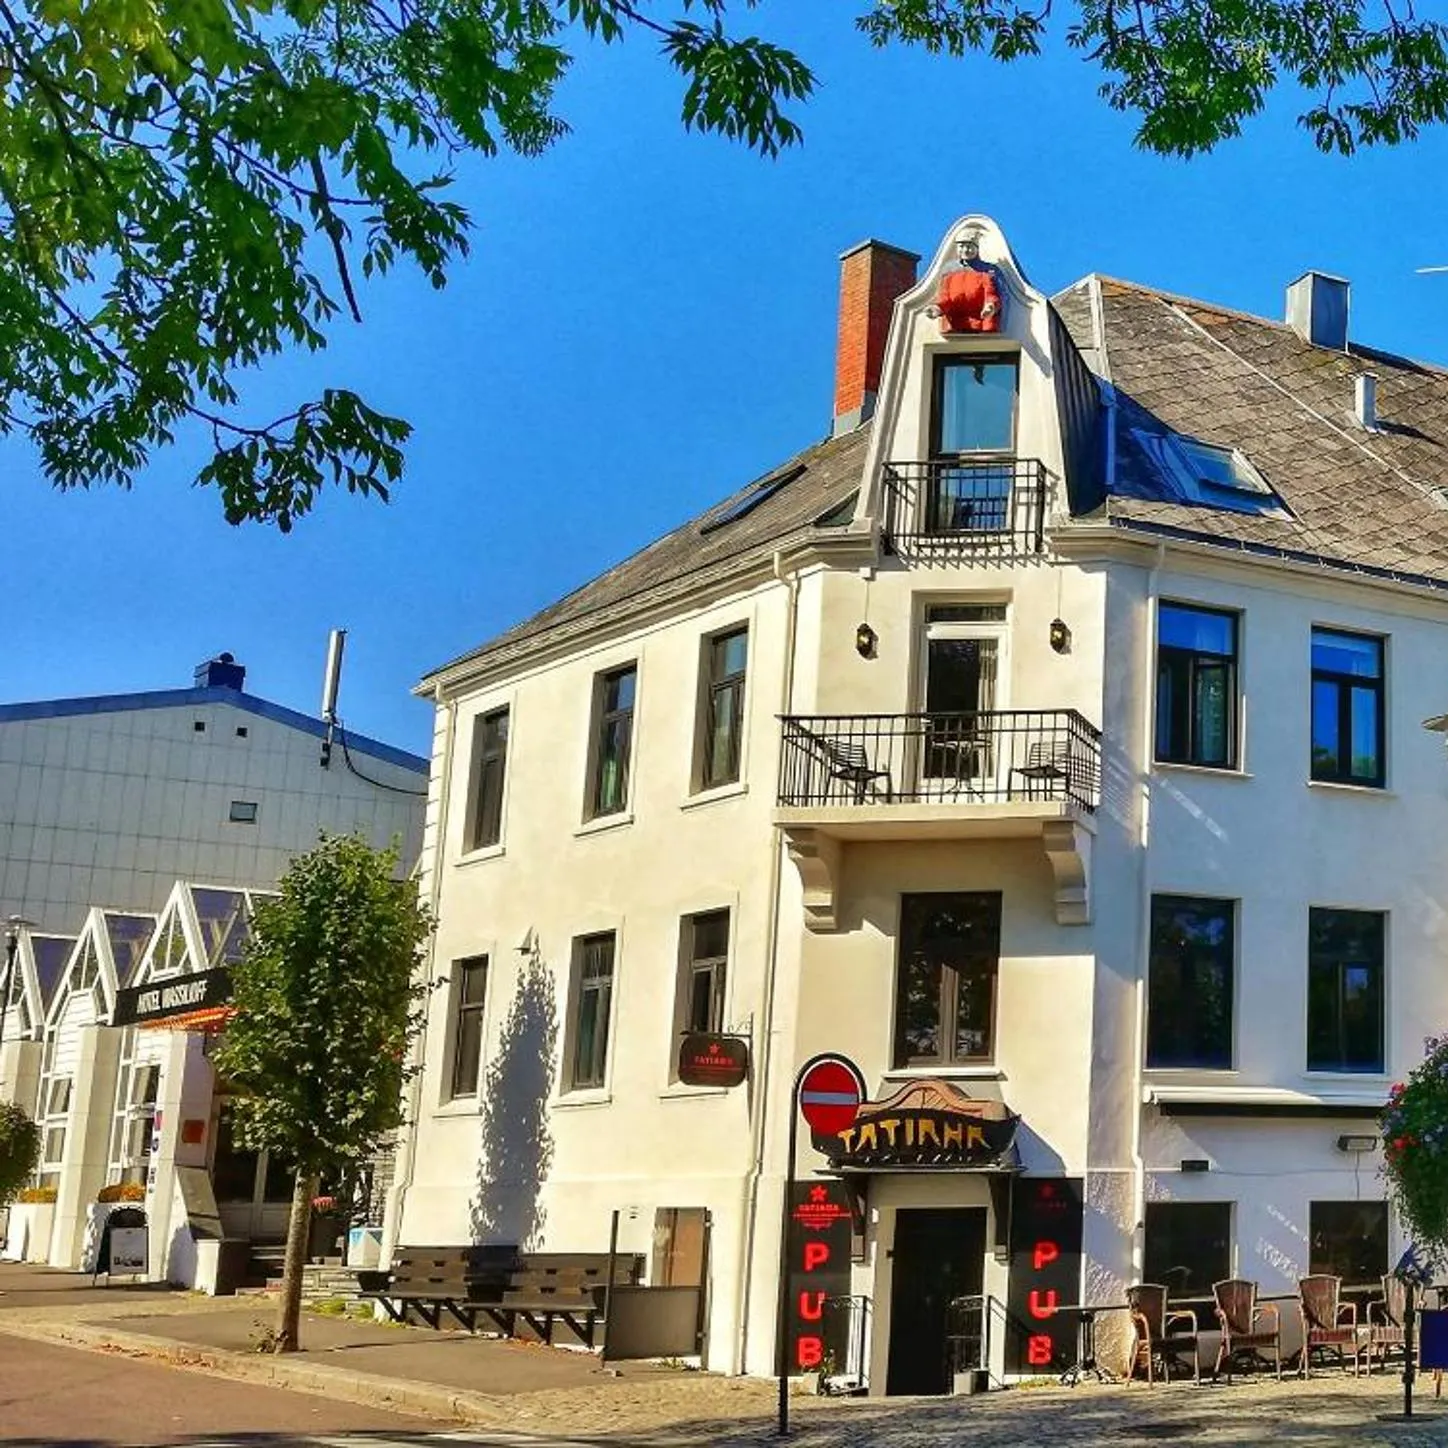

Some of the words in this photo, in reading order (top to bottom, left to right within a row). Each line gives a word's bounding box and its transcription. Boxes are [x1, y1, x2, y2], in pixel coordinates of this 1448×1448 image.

[137, 988, 160, 1014] HOTEL
[798, 1241, 830, 1370] PUB
[1028, 1240, 1060, 1366] PUB
